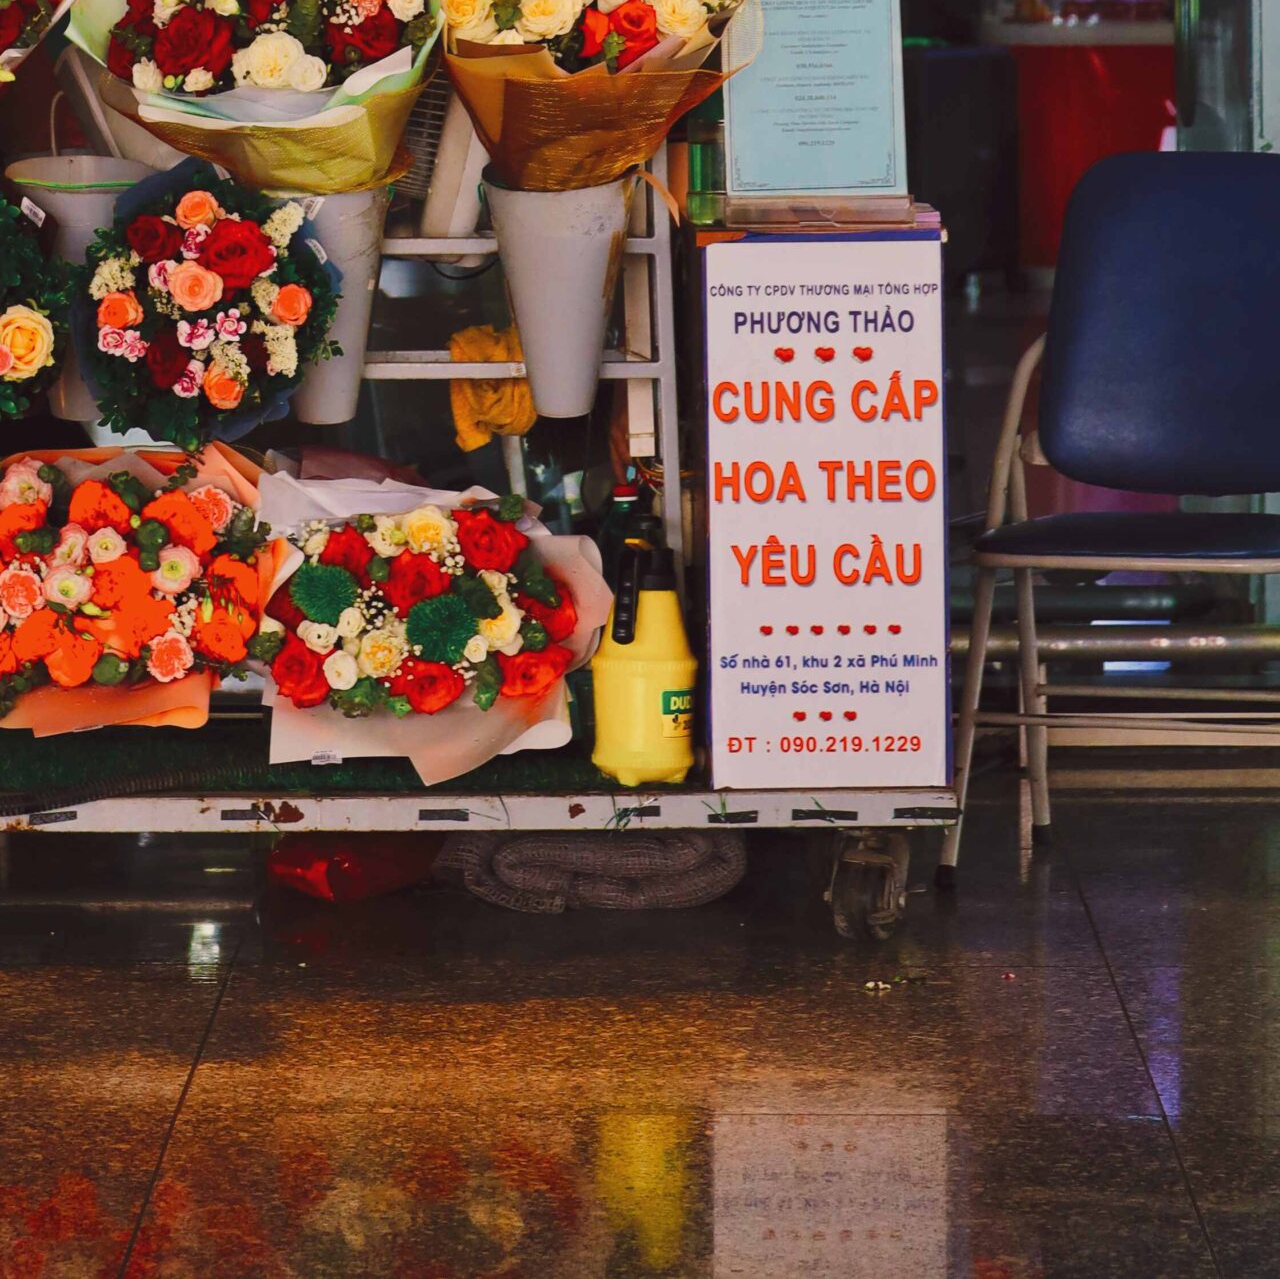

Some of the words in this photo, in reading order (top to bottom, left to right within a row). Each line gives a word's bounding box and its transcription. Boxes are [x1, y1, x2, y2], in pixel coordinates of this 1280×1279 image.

[710, 283, 743, 297] CÔNG
[747, 285, 761, 296] TY
[764, 285, 796, 296] CPDV
[734, 311, 840, 334] PHƯƠNG
[849, 305, 915, 333] THẢO
[712, 380, 836, 422] CUNG
[850, 370, 939, 422] CẤP
[714, 460, 807, 502] HOA
[818, 459, 936, 502] THEO
[730, 535, 817, 586] YÊU
[833, 534, 922, 586] CẦU
[720, 653, 739, 669] Số
[742, 656, 770, 669] nhà
[775, 655, 797, 670] 61,
[802, 656, 828, 668] khu
[834, 655, 842, 668] 2
[847, 656, 866, 668] xã
[871, 654, 898, 668] Phú
[903, 655, 938, 668] Minh
[741, 681, 787, 697] Huyện
[791, 681, 818, 694] Sóc
[823, 681, 855, 695] Sơn,
[860, 680, 880, 694] Hà
[885, 680, 910, 697] Nội
[727, 736, 757, 753] ĐT
[780, 735, 921, 753] 090.219.1229
